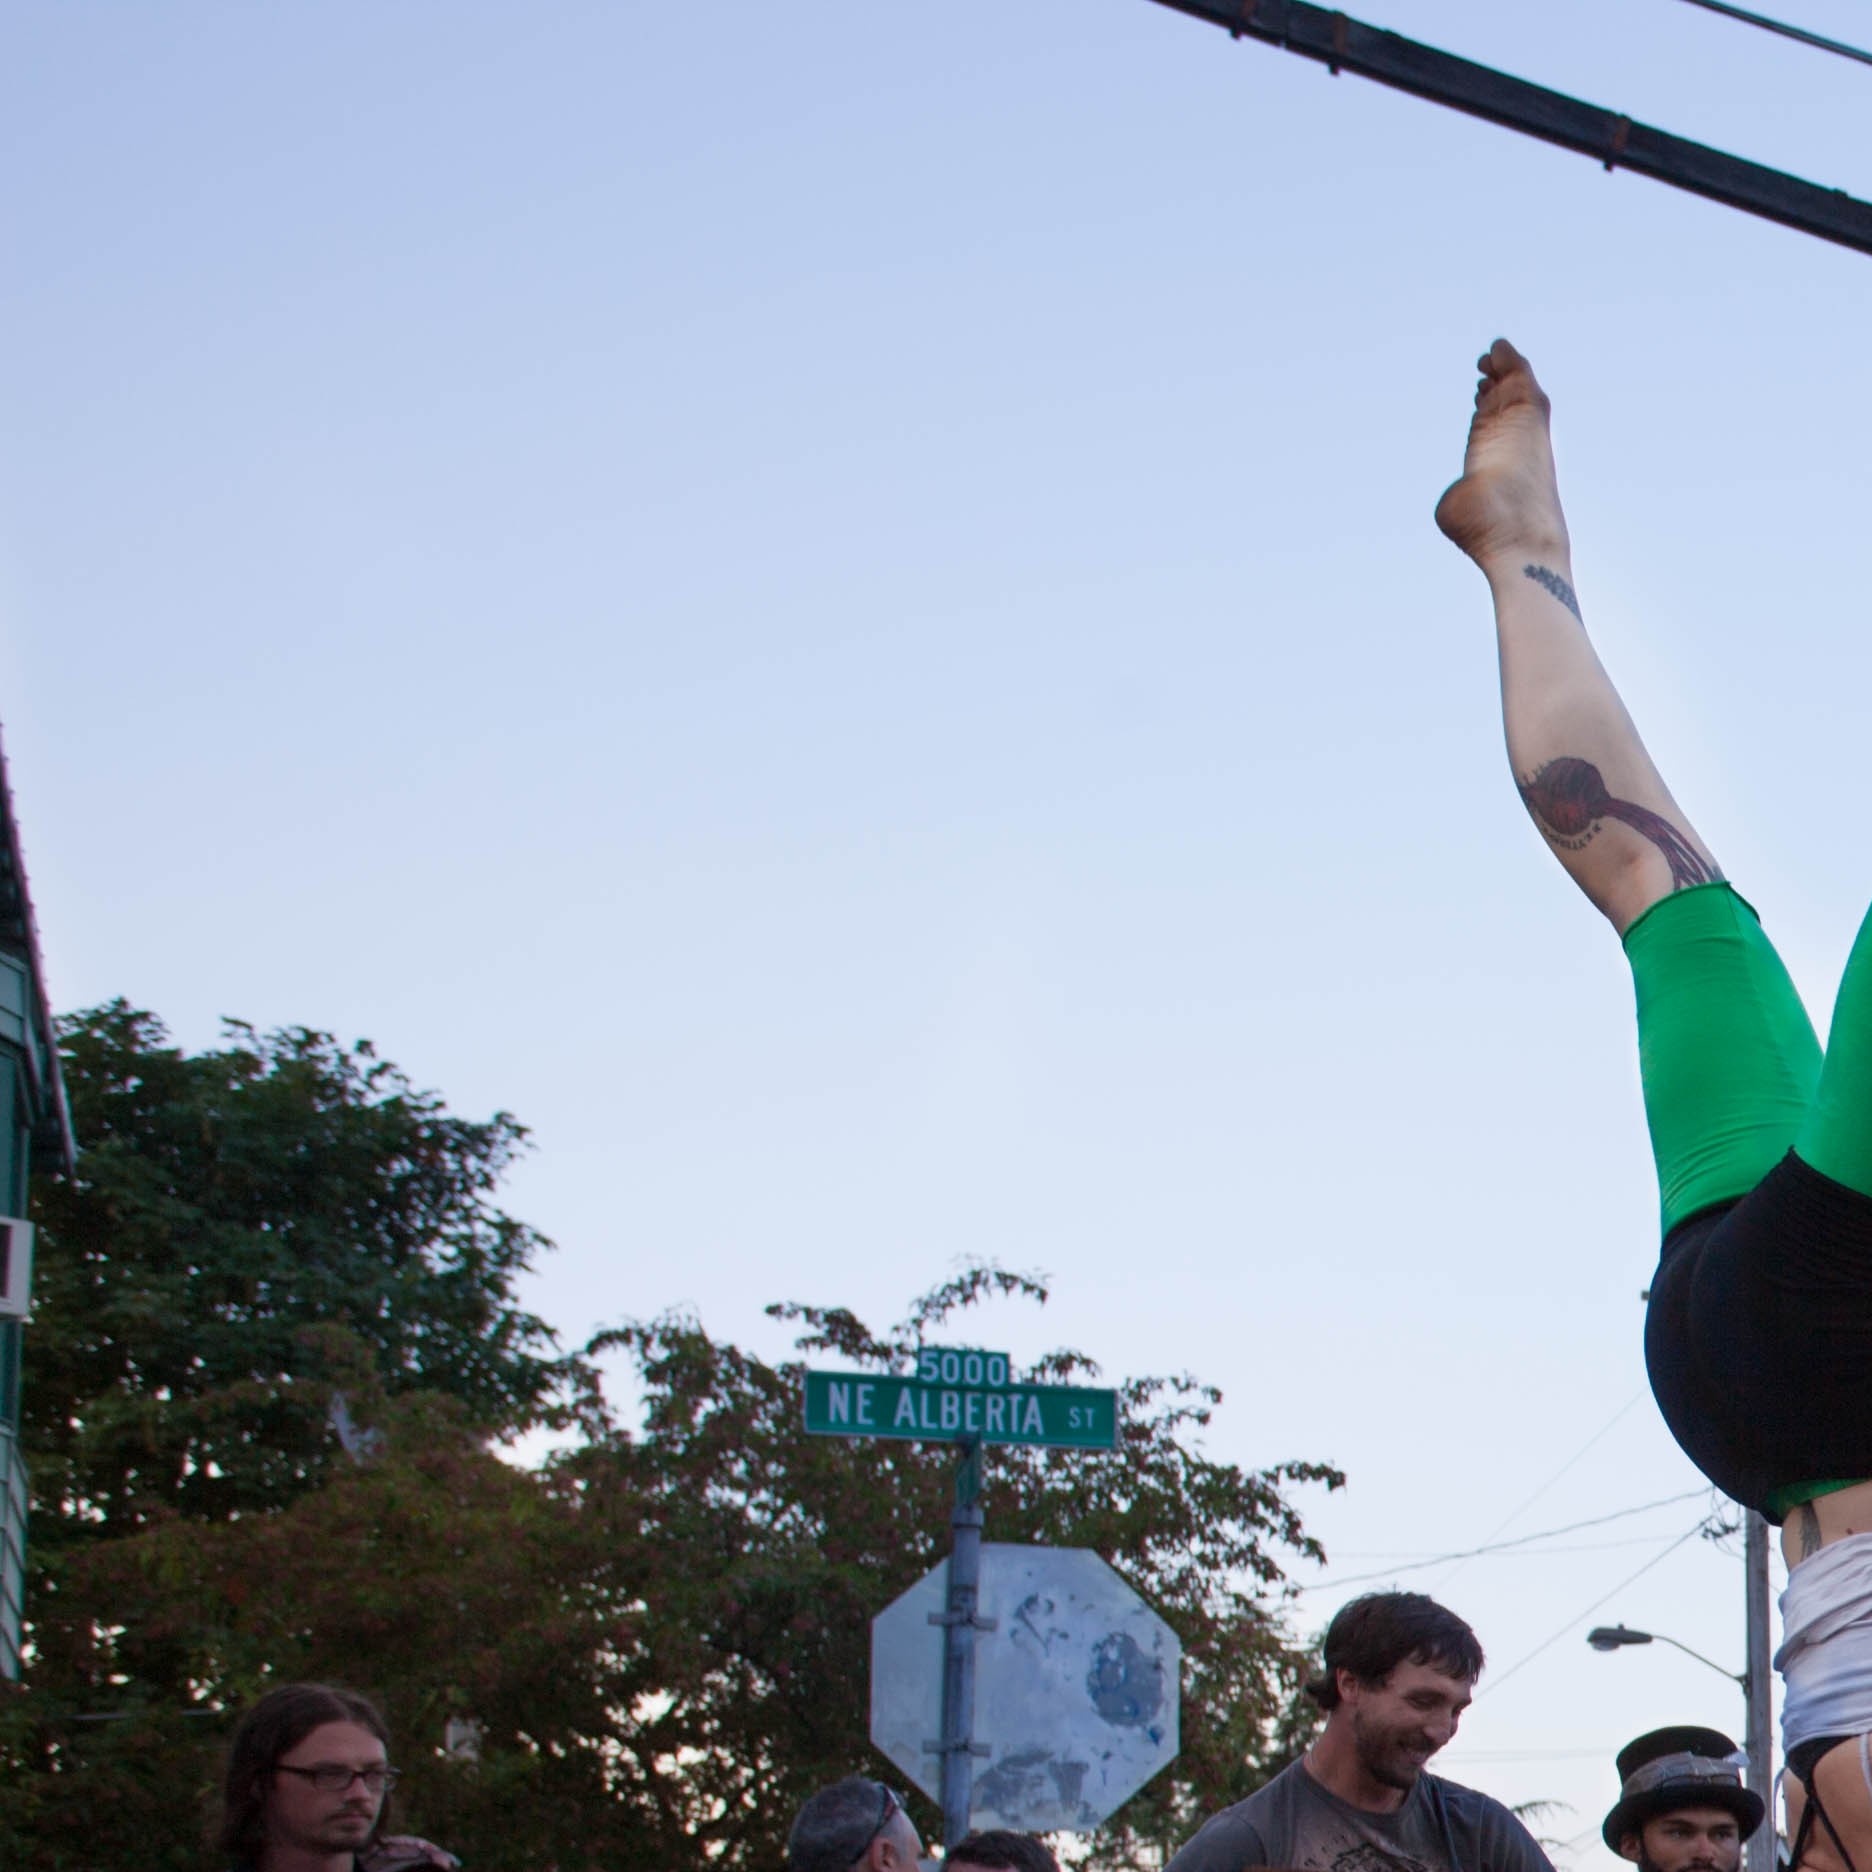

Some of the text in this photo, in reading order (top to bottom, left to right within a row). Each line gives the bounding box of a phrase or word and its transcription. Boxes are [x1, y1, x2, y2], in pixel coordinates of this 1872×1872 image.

[920, 1351, 1006, 1387] 5000
[828, 1381, 1096, 1436] NE ALBERTA ST
